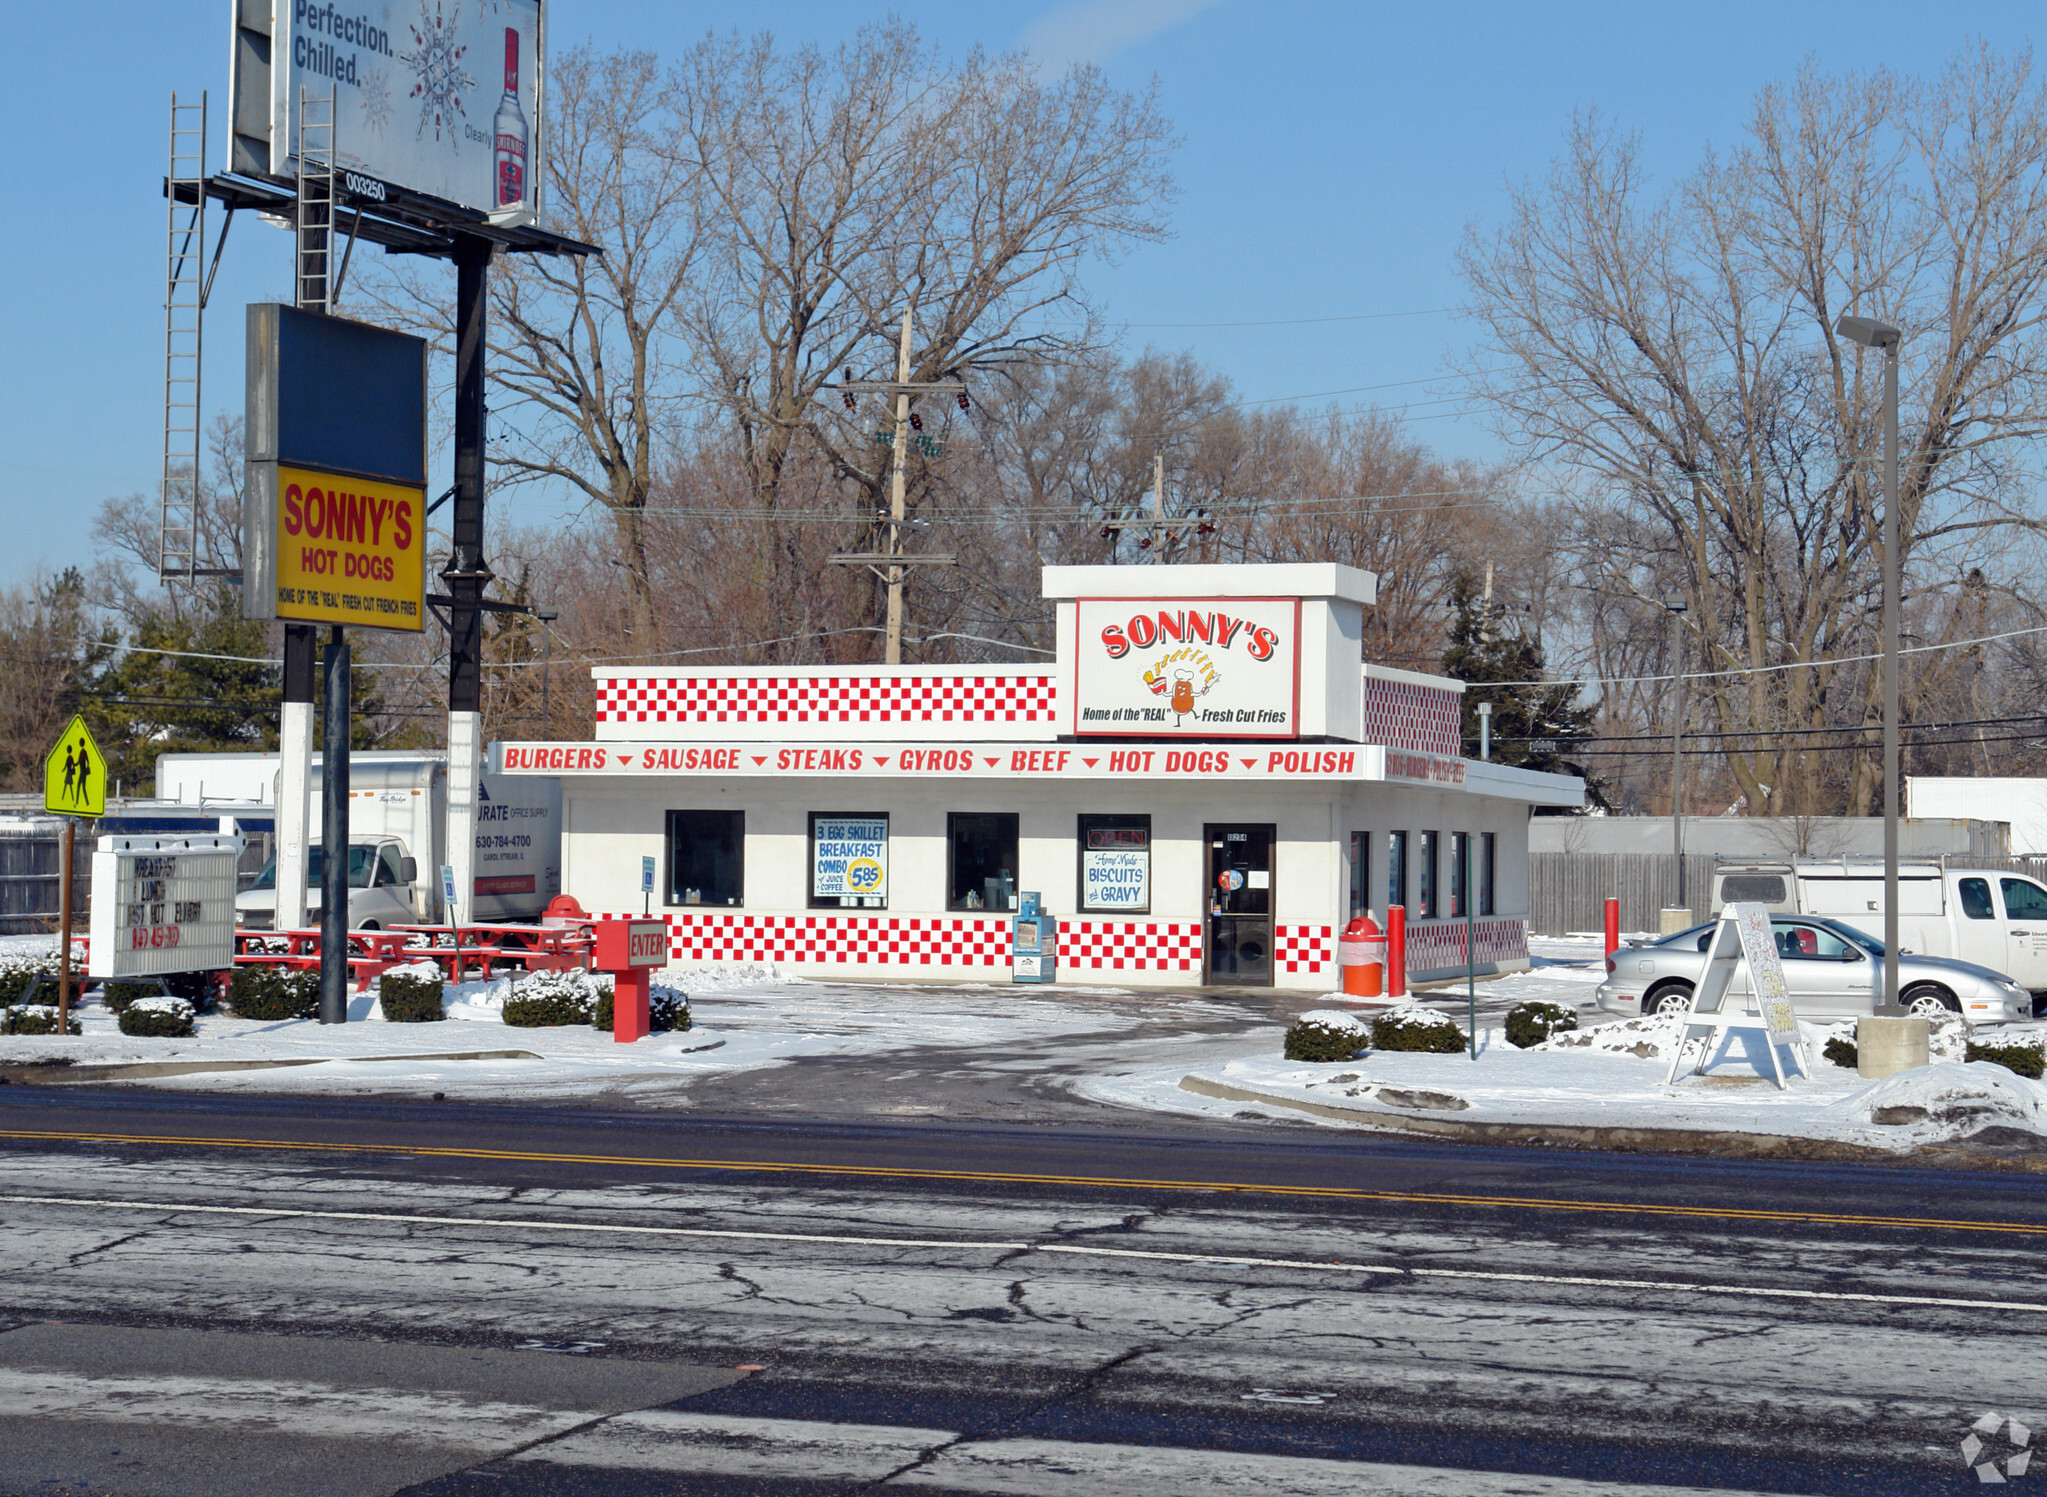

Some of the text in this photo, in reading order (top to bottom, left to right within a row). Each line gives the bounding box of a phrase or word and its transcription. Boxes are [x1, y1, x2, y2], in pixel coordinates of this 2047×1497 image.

[295, 0, 394, 58] Perfection.
[295, 35, 361, 88] Chilled.
[465, 123, 492, 150] Clearly
[497, 135, 526, 156] SMIRNOFF
[346, 172, 385, 201] 003250
[284, 483, 412, 551] SONNY'S
[301, 546, 395, 583] HOT DOGS
[278, 587, 296, 604] HOME
[297, 589, 305, 605] OF
[307, 590, 319, 606] THE
[342, 594, 361, 611] FRESH
[363, 596, 375, 612] CUT
[376, 597, 399, 614] FRENCH
[400, 600, 417, 616] FRIES
[1101, 609, 1279, 663] SONNY'S
[1082, 707, 1111, 721] Home
[1112, 707, 1124, 721] of
[1124, 707, 1140, 721] the
[1201, 708, 1234, 722] Fresh
[1236, 709, 1256, 723] Cut
[1257, 709, 1287, 724] Fries
[504, 748, 1356, 773] BURGERS SAUSAGE STEAKS GYROS BEEF HOT DOGS POLISH
[510, 808, 529, 818] OFFICE
[529, 807, 549, 818] SUPPLY
[817, 826, 885, 841] 3 EGG SKILLET
[1089, 831, 1144, 848] OPEN
[483, 853, 499, 861] CAROL
[819, 843, 882, 857] BREAKFAST
[818, 860, 848, 874] COMBO
[1089, 868, 1143, 883] BISCUITS
[820, 883, 844, 891] COFFEE
[826, 875, 844, 883] JUICE
[1101, 886, 1141, 902] GRAVY
[151, 903, 165, 925] HOT
[631, 933, 664, 957] ENTER
